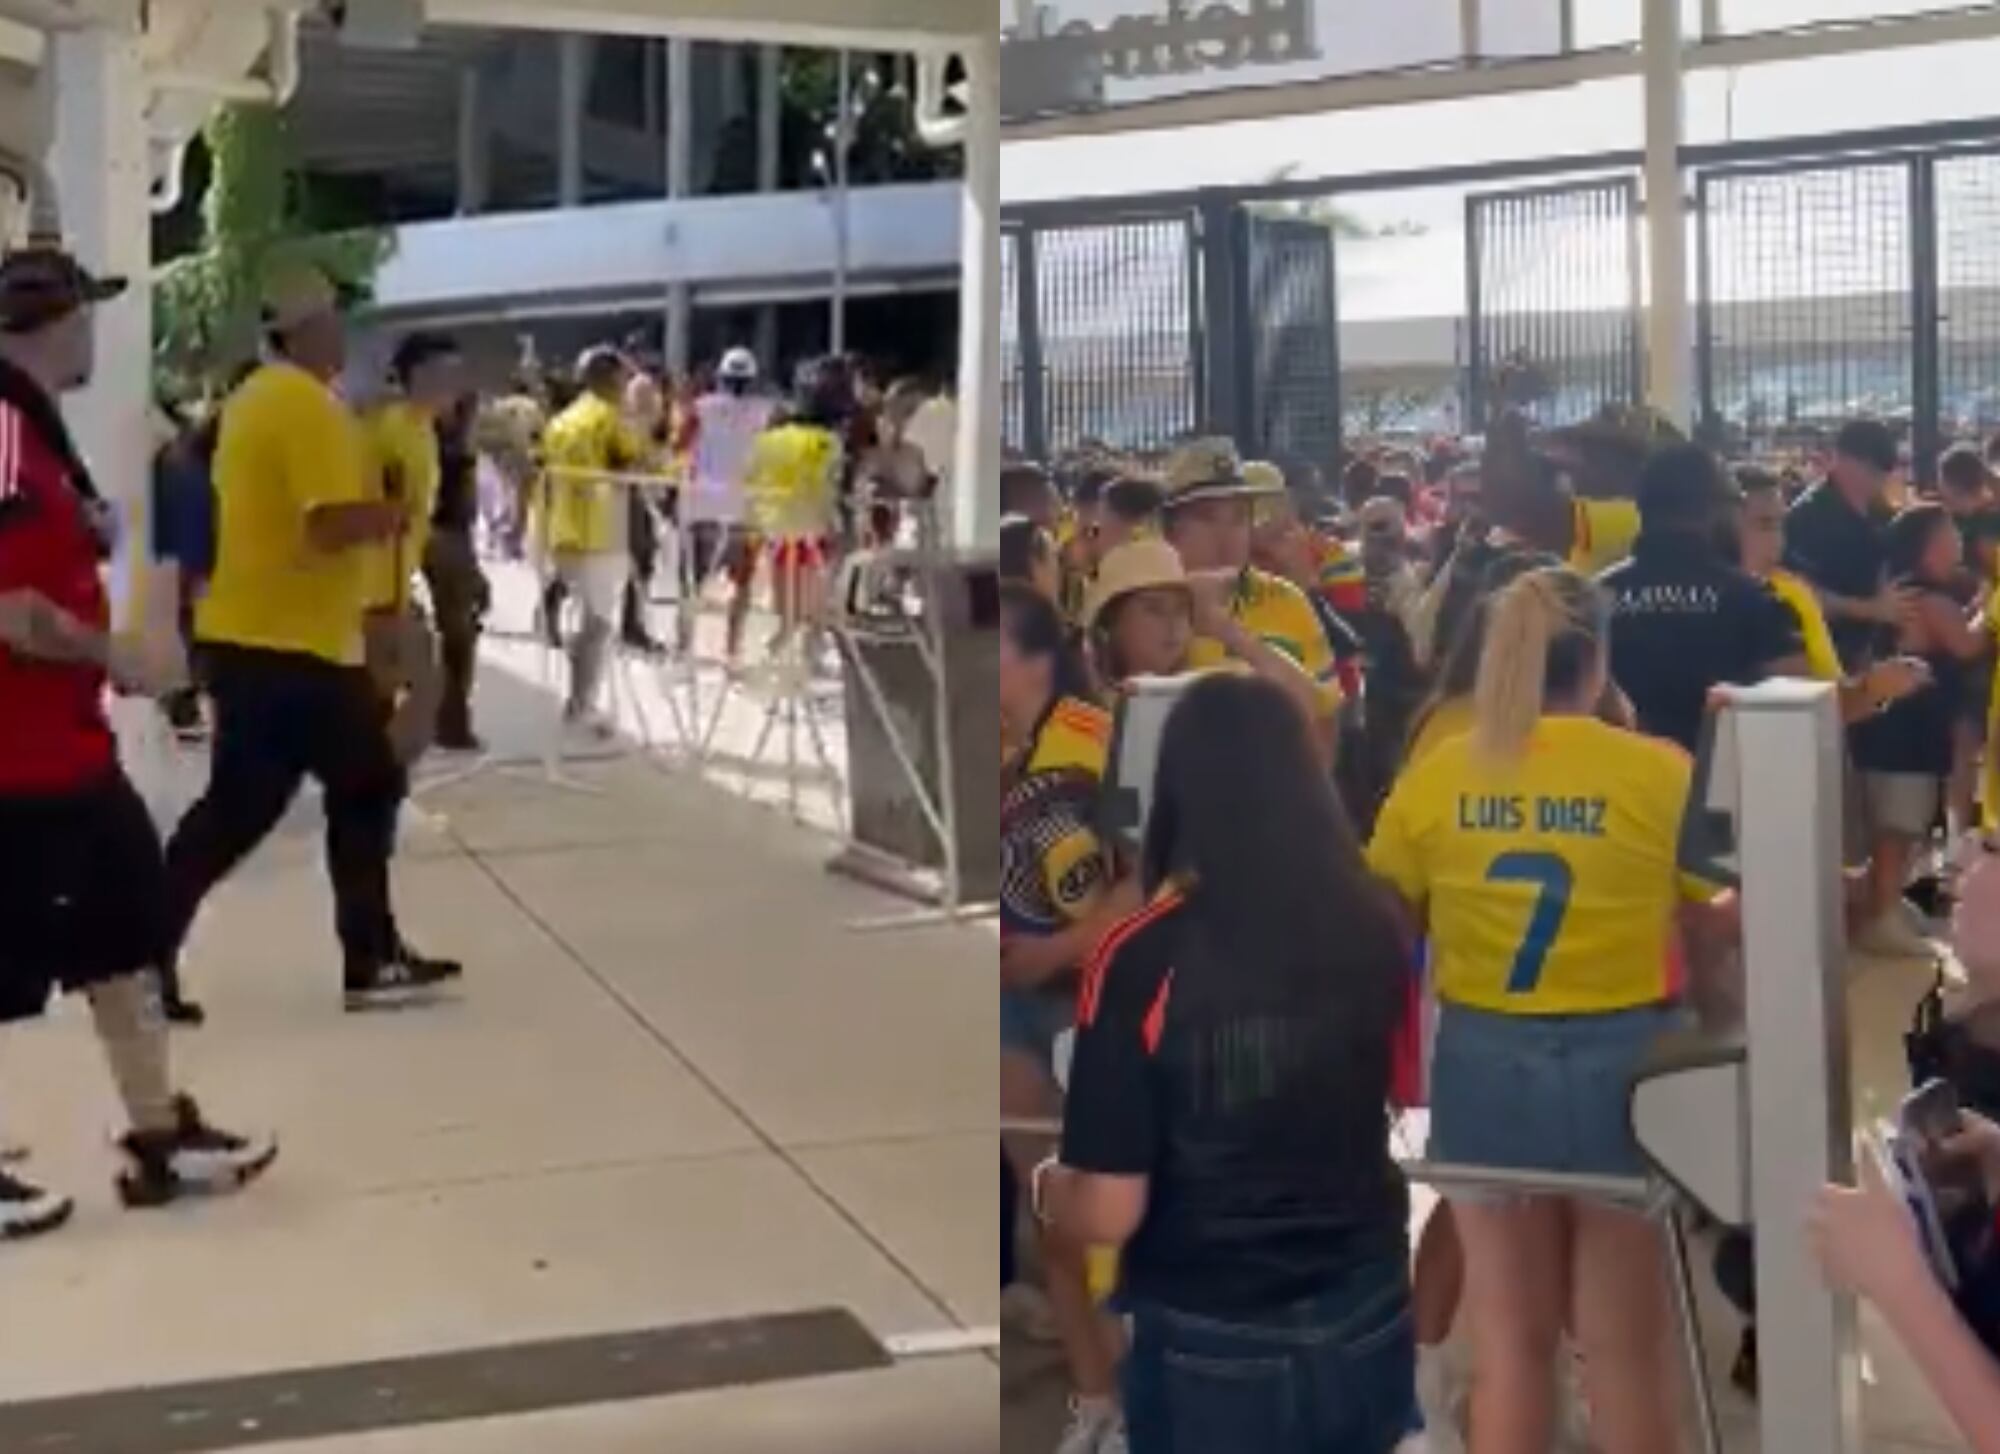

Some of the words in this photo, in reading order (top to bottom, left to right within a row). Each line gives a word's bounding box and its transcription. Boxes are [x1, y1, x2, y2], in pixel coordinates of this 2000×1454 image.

[1458, 794, 1525, 832] LUIS
[1538, 795, 1607, 837] DIAZ
[1484, 851, 1575, 993] 7
